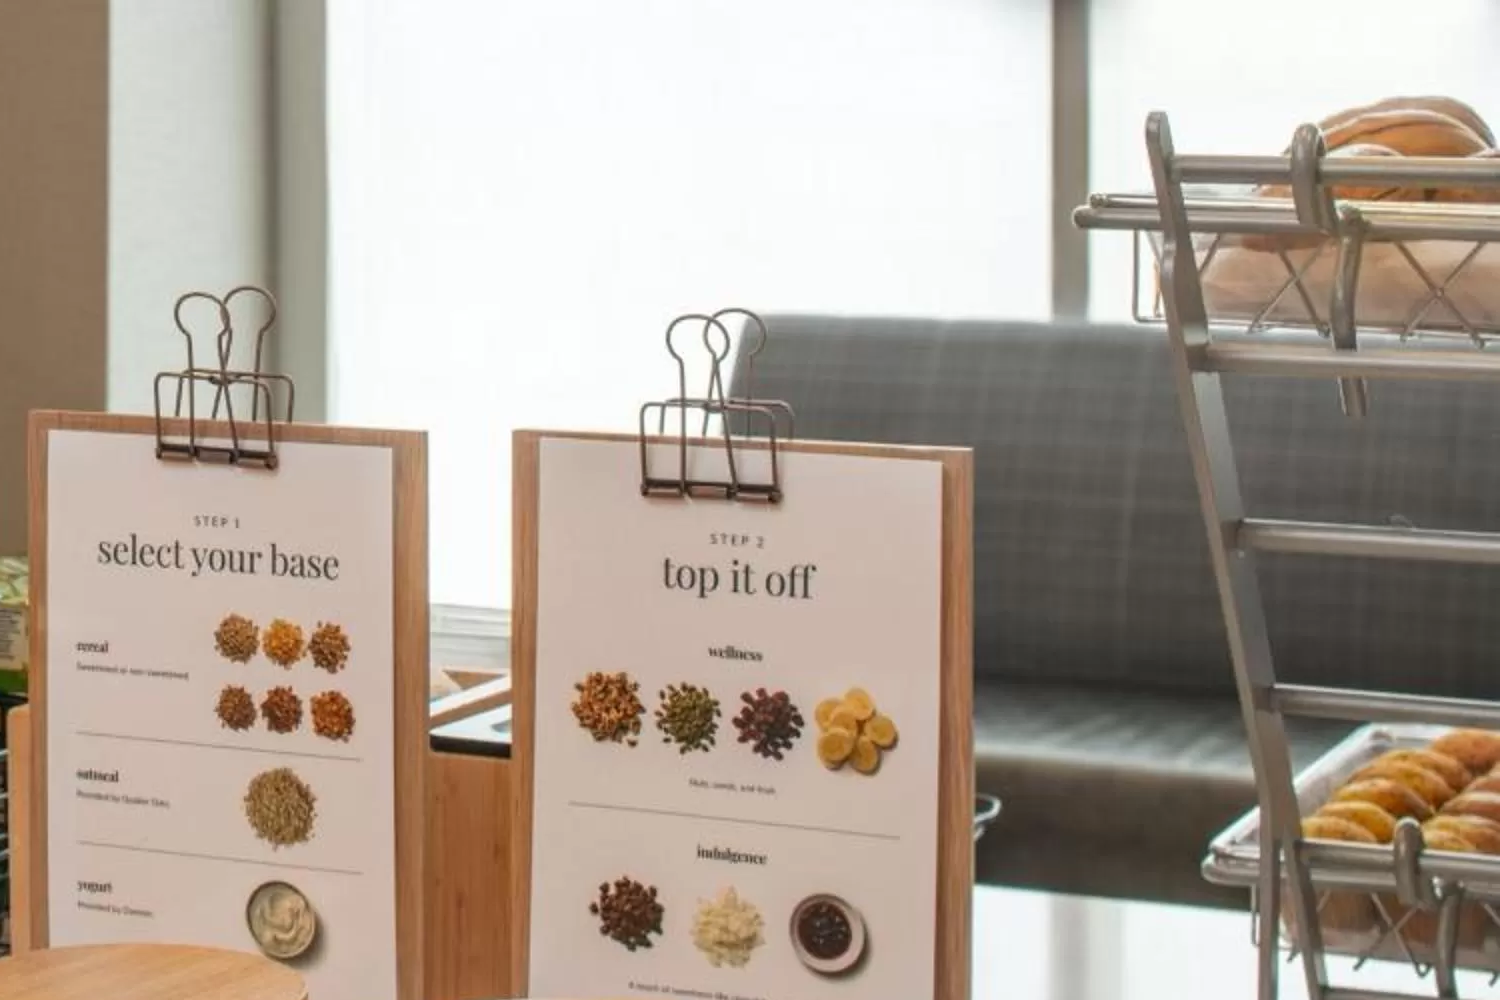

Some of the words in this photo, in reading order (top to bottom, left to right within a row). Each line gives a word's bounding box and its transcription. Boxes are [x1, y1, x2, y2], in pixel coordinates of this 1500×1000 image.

[193, 515, 229, 528] STEP
[235, 517, 240, 529] 1
[709, 533, 749, 546] STEP
[756, 536, 765, 549] 2
[98, 533, 185, 569] select
[190, 544, 263, 577] your
[270, 543, 339, 580] base
[663, 557, 719, 598] top
[731, 559, 757, 595] it
[765, 564, 817, 599] off
[76, 640, 109, 653] cereal
[708, 645, 763, 661] wellness
[76, 769, 119, 783] oatmeal
[696, 843, 768, 866] indulgence
[77, 880, 113, 895] yogurt
